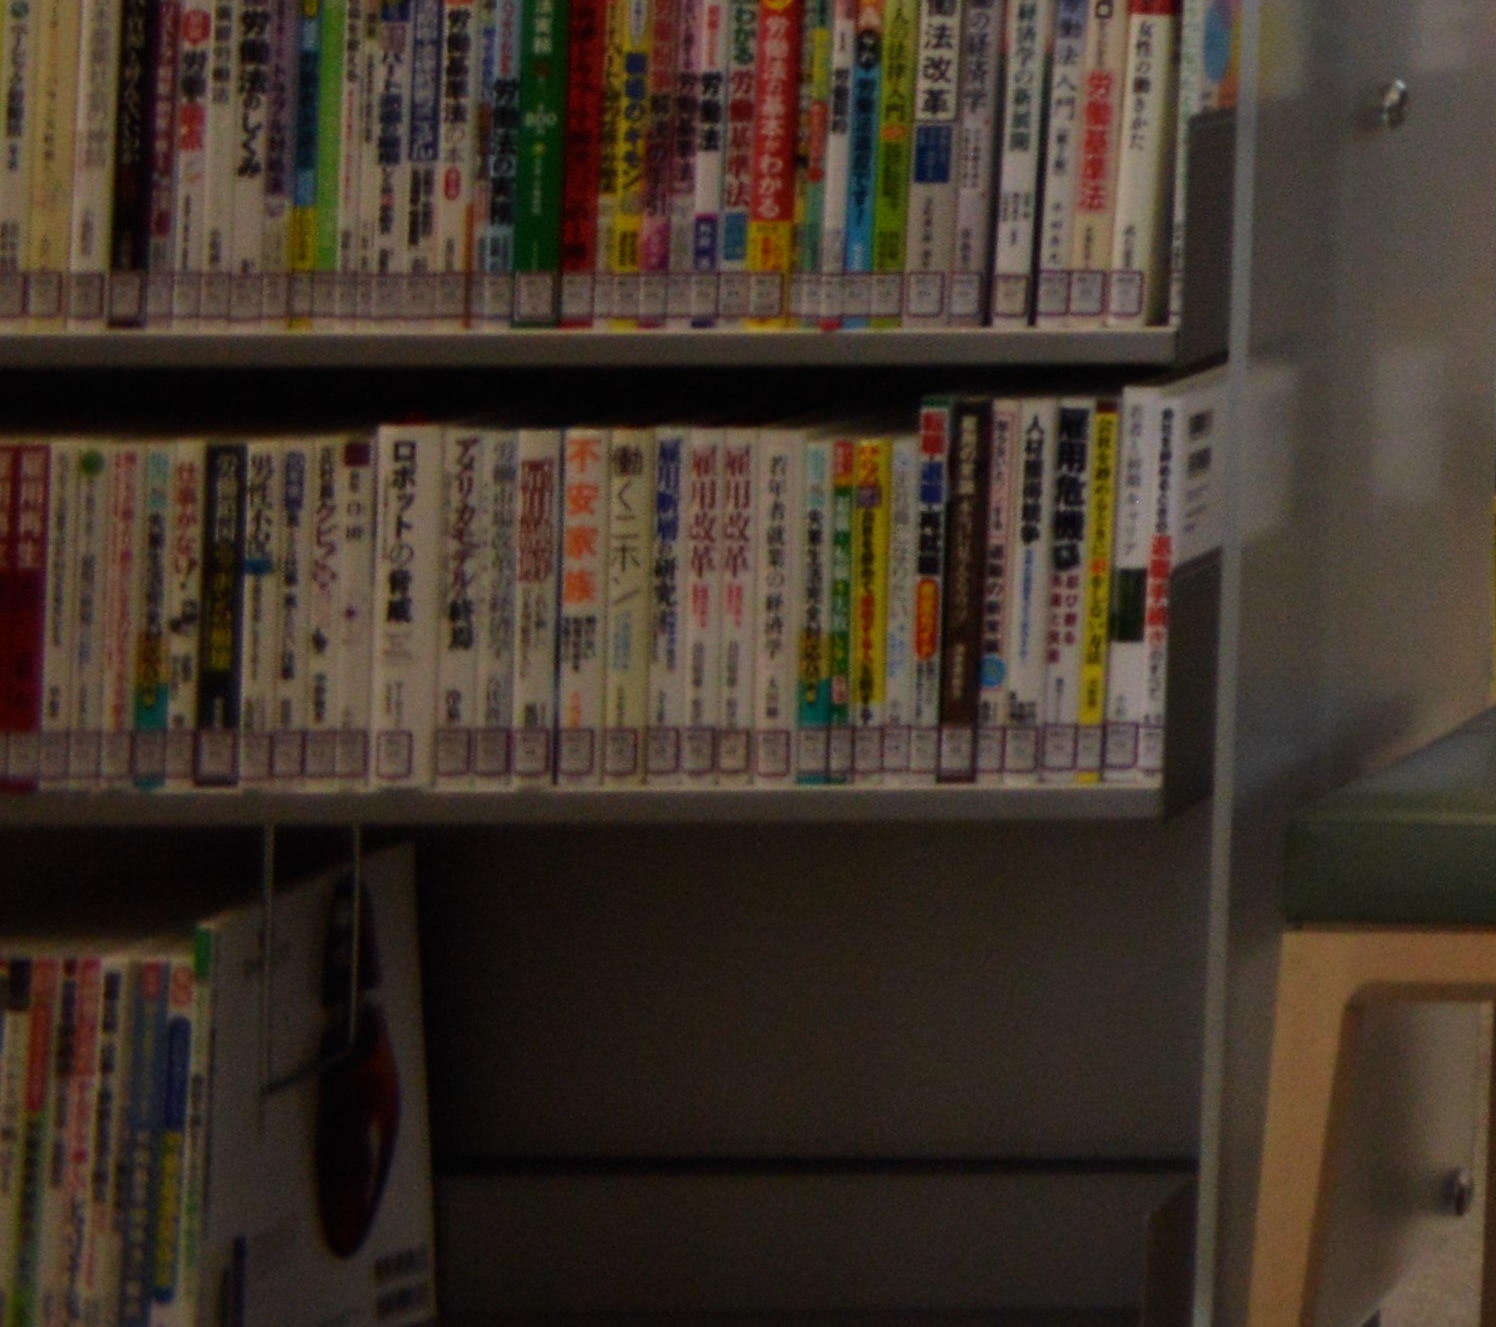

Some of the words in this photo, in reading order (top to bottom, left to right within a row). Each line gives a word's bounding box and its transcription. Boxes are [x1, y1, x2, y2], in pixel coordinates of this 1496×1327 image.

[760, 14, 793, 220] 労働法の基本がわかる
[1126, 23, 1156, 153] 女性の働きかた
[387, 439, 420, 626] ロボットの脅威
[564, 437, 604, 608] 不安家族
[612, 445, 645, 608] 働くニホン
[690, 439, 717, 580] 雇用改革
[723, 439, 752, 580] 雇用改革
